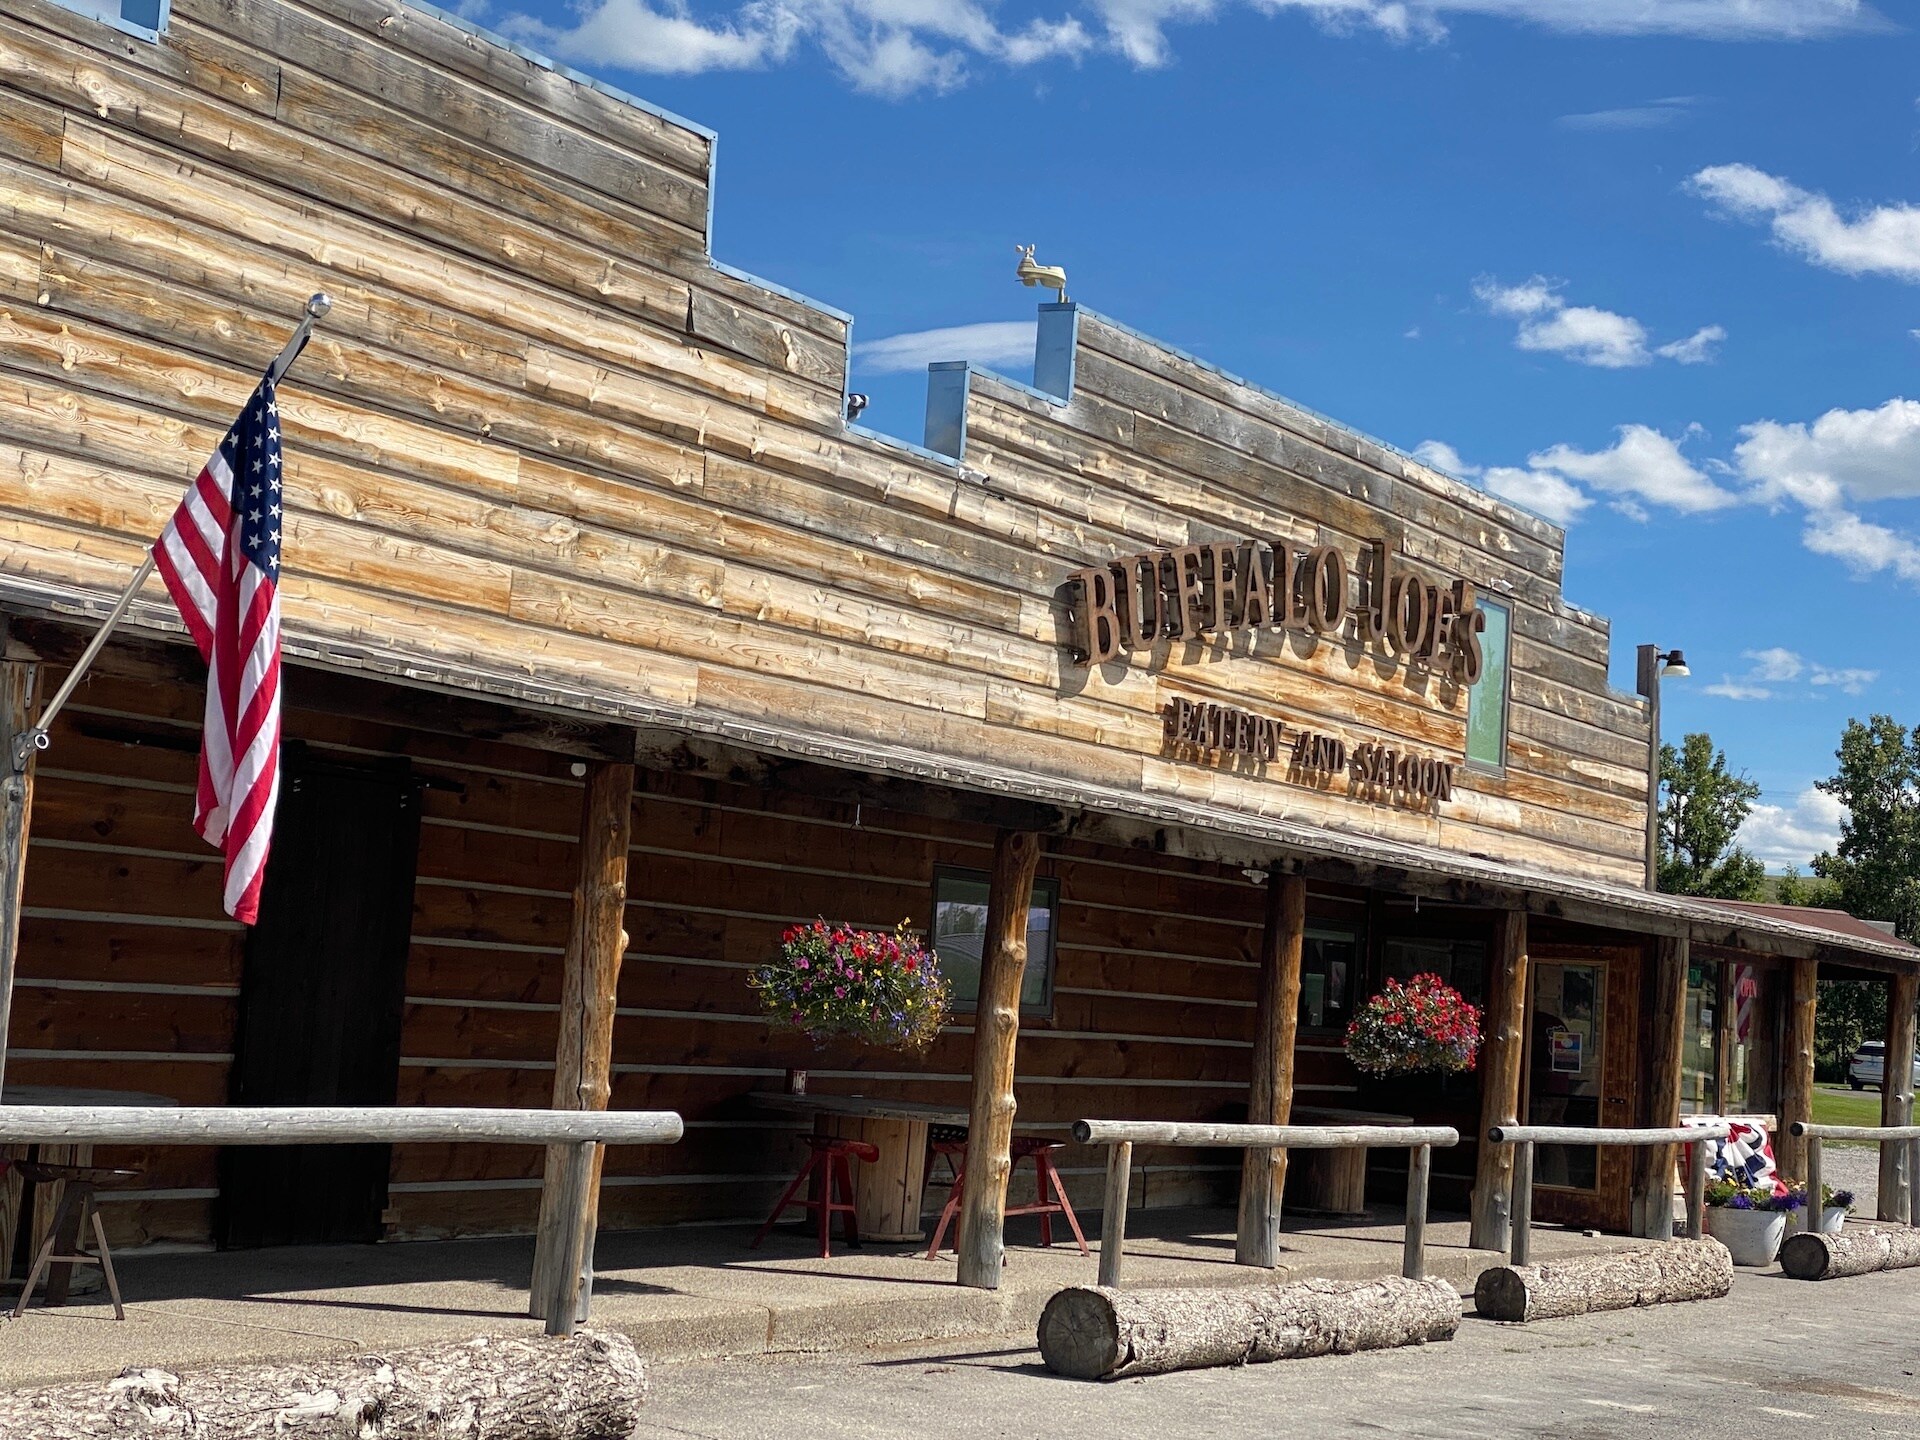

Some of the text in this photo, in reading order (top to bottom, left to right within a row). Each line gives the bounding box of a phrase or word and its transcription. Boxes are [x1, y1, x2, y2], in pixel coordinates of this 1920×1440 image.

[1066, 538, 1487, 685] BUFFALO JOE'S
[1172, 696, 1452, 802] EATERY AND SALOON
